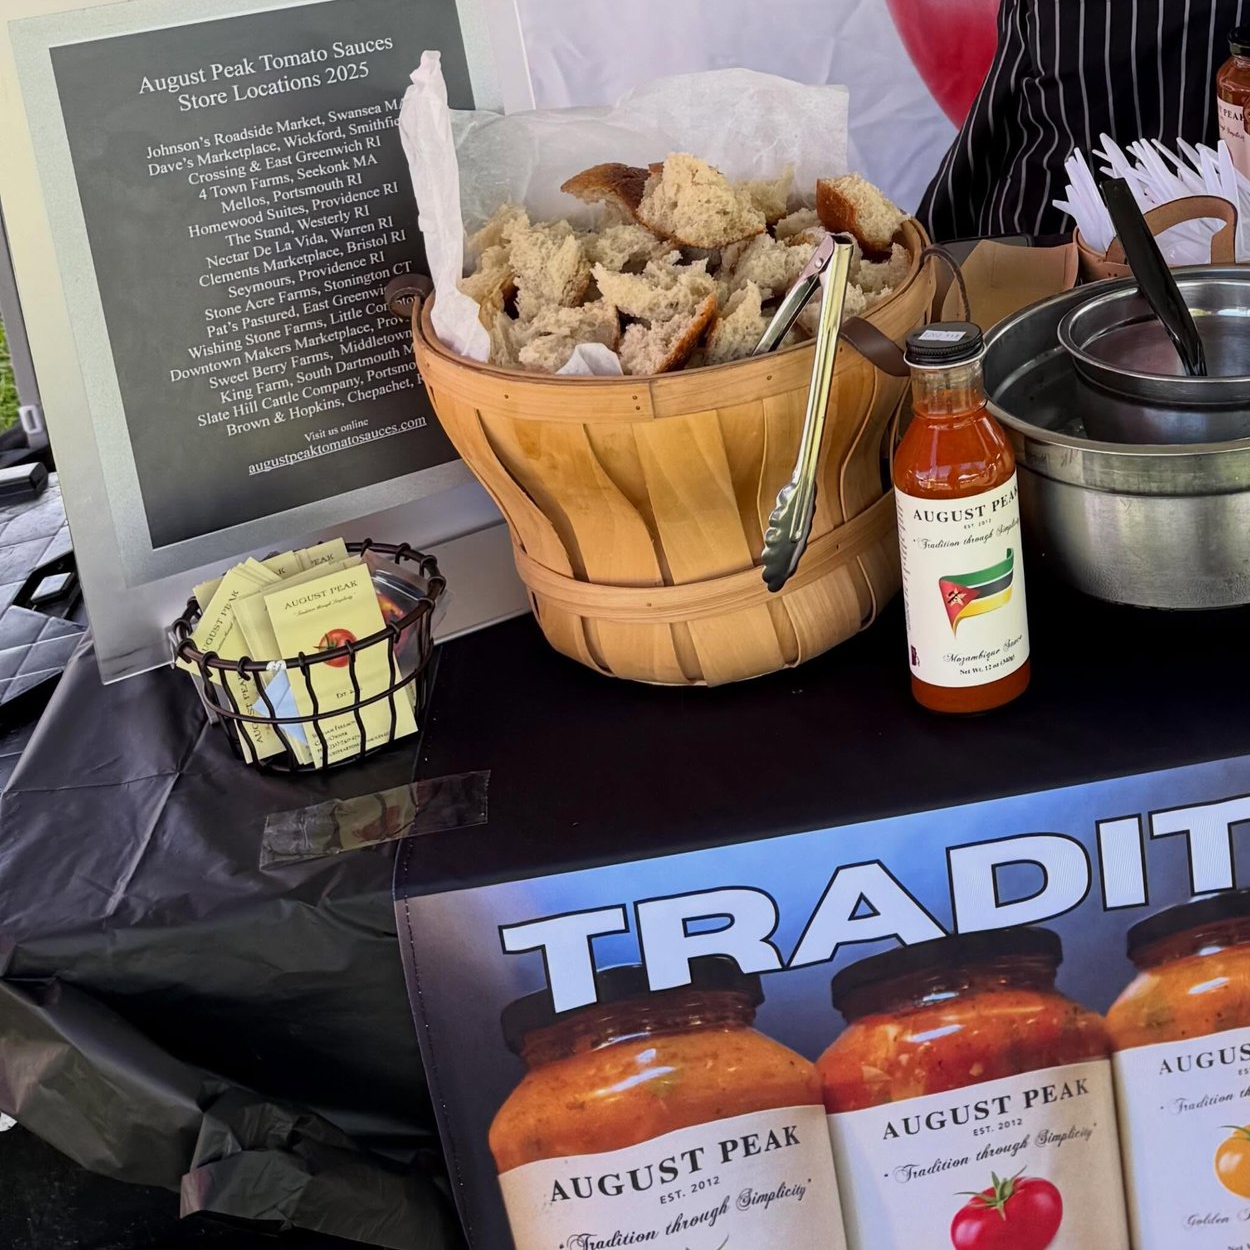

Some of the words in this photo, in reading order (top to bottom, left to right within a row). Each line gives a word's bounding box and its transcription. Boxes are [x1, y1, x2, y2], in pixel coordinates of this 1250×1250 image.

[138, 68, 207, 97] August
[209, 57, 257, 81] Peak
[258, 48, 328, 72] Tomato
[332, 37, 394, 59] Sauces
[177, 91, 228, 112] Store
[231, 74, 322, 102] Locations
[324, 60, 369, 85] 2025
[146, 136, 211, 159] Johnson’s
[213, 124, 274, 146] Roadside
[275, 114, 326, 133] Market,
[327, 104, 382, 123] Swansea
[147, 157, 195, 177] Dave’s
[196, 142, 281, 167] Marketplace,
[283, 126, 346, 148] Wickford,
[347, 116, 401, 136] Smithfie
[187, 165, 247, 185] Crossing
[249, 160, 262, 173] &
[264, 155, 293, 170] East
[295, 139, 363, 163] Greenwich
[365, 135, 381, 149] RI
[198, 188, 208, 200] 4
[209, 183, 248, 198] Town
[249, 174, 294, 191] Farms,
[296, 158, 351, 180] Seekonk
[352, 153, 378, 169] MA
[187, 210, 264, 238] Homewood
[266, 204, 310, 221] Suites,
[311, 188, 381, 211] Providence
[382, 181, 399, 196] RI
[220, 195, 271, 214] Mellos,
[272, 177, 345, 203] Portsmouth
[346, 172, 363, 187] RI
[205, 250, 250, 269] Nectar
[252, 245, 273, 259] De
[274, 240, 293, 254] La
[293, 232, 329, 248] Vida,
[329, 222, 376, 240] Warren
[377, 215, 394, 230] RI
[224, 232, 252, 247] The
[253, 221, 295, 241] Stand,
[296, 209, 351, 231] Westerly
[353, 204, 370, 219] RI
[198, 266, 260, 288] Clements
[262, 247, 344, 274] Marketplace,
[345, 233, 388, 254] Bristol
[390, 229, 407, 244] RI
[227, 276, 296, 299] Seymours,
[297, 258, 367, 282] Providence
[369, 250, 385, 265] RI
[204, 304, 242, 321] Stone
[244, 297, 276, 312] Acre
[278, 286, 322, 304] Farms,
[323, 268, 391, 292] Stonington
[392, 260, 412, 275] CT
[206, 321, 239, 339] Pat’s
[241, 305, 300, 330] Pastured,
[302, 299, 330, 315] East
[331, 283, 387, 307] Greenwi
[169, 356, 242, 383] Downtown
[243, 343, 292, 364] Makers
[294, 323, 375, 351] Marketplace,
[187, 339, 243, 359] Wishing
[244, 329, 282, 346] Stone
[283, 319, 328, 337] Farms,
[329, 307, 363, 325] Little
[209, 370, 250, 389] Sweet
[251, 361, 288, 379] Berry
[290, 351, 334, 369] Farms,
[339, 329, 413, 356] Middletown
[197, 410, 231, 427] Slate
[232, 400, 259, 418] Hill
[261, 391, 300, 410] Cattle
[301, 376, 364, 399] Company,
[366, 362, 416, 382] Portsmo
[219, 388, 254, 404] King
[255, 378, 294, 395] Farm,
[295, 364, 333, 384] South
[334, 347, 401, 374] Dartmouth
[226, 417, 271, 437] Brown
[273, 411, 287, 424] &
[288, 398, 345, 420] Hopkins,
[347, 378, 415, 403] Chepachet,
[303, 429, 327, 442] Visit
[327, 427, 339, 436] us
[340, 419, 369, 433] online
[248, 416, 428, 476] augustpeaktomatosauces.com
[914, 505, 986, 523] AUGUST
[284, 590, 328, 610] AUGUST
[330, 580, 358, 595] PEAK
[201, 618, 224, 653] UGUST
[943, 648, 1001, 666] Mozambique
[883, 1095, 1011, 1141] AUGUST
[1023, 1078, 1090, 1110] PEAK
[973, 1124, 995, 1137] EST.
[998, 1118, 1023, 1132] 2012
[550, 1146, 705, 1202] AUGUST
[718, 1125, 801, 1164] PEAK
[976, 1138, 1030, 1169] through
[660, 1191, 685, 1205] EST.
[691, 1175, 720, 1193] 2012
[666, 1196, 730, 1236] through
[1182, 1211, 1231, 1230] Golden
